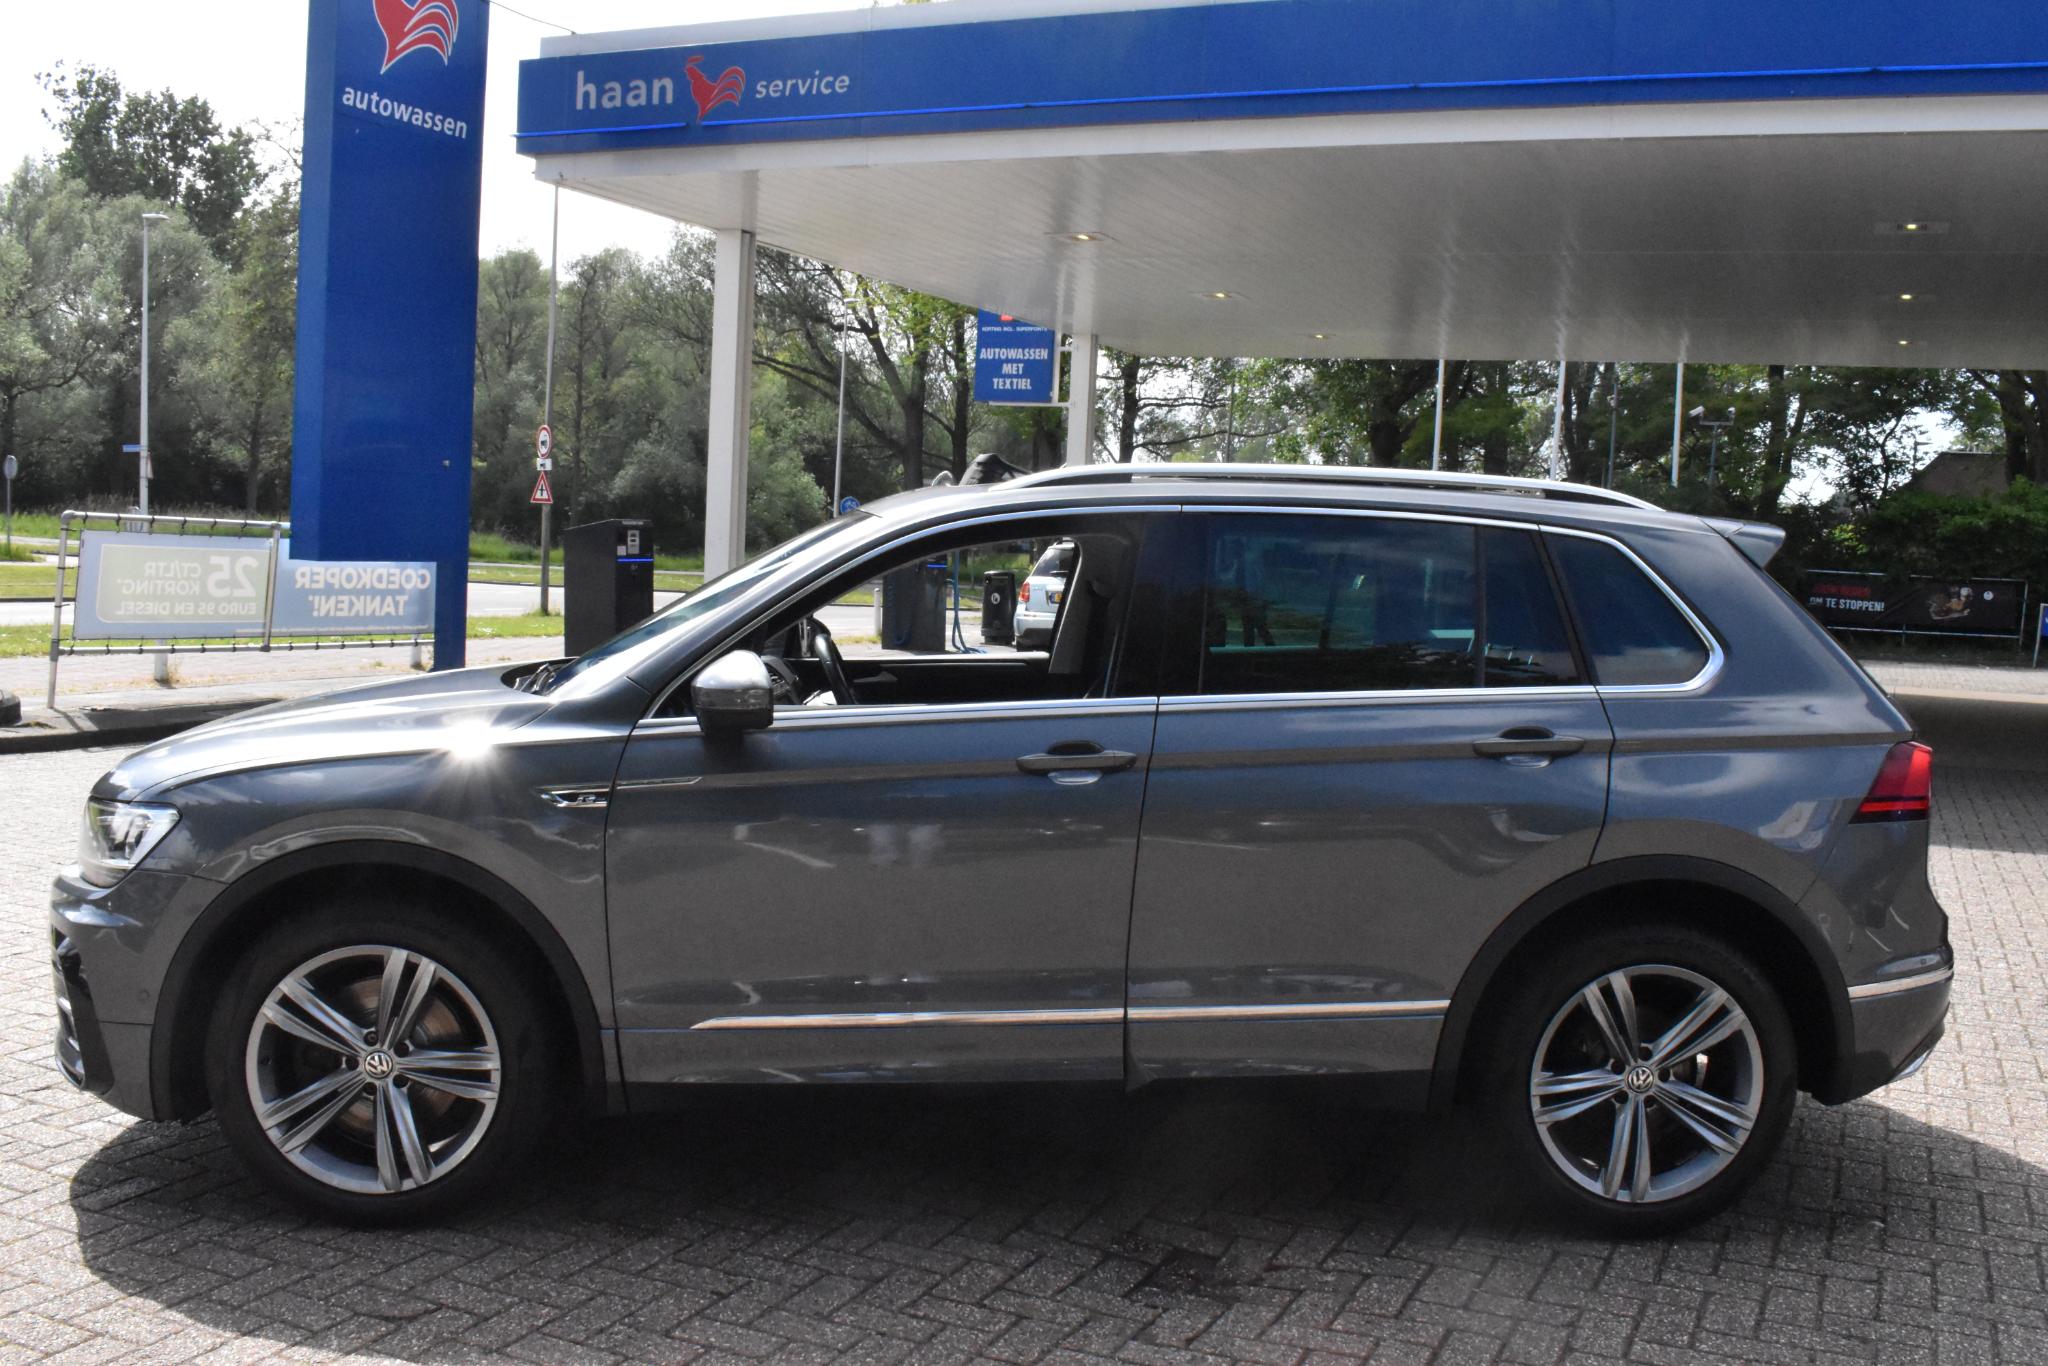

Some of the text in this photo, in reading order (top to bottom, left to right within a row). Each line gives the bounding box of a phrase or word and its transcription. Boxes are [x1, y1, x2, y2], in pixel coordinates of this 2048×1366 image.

[576, 70, 674, 111] haan
[755, 69, 850, 98] service
[342, 86, 467, 139] autowassen
[980, 348, 1048, 360] AUTOWASSEN
[1002, 363, 1024, 375] MET
[993, 378, 1032, 390] TEXTIEL
[1825, 598, 1838, 609] TE
[1839, 598, 1885, 612] STOPPEN!
